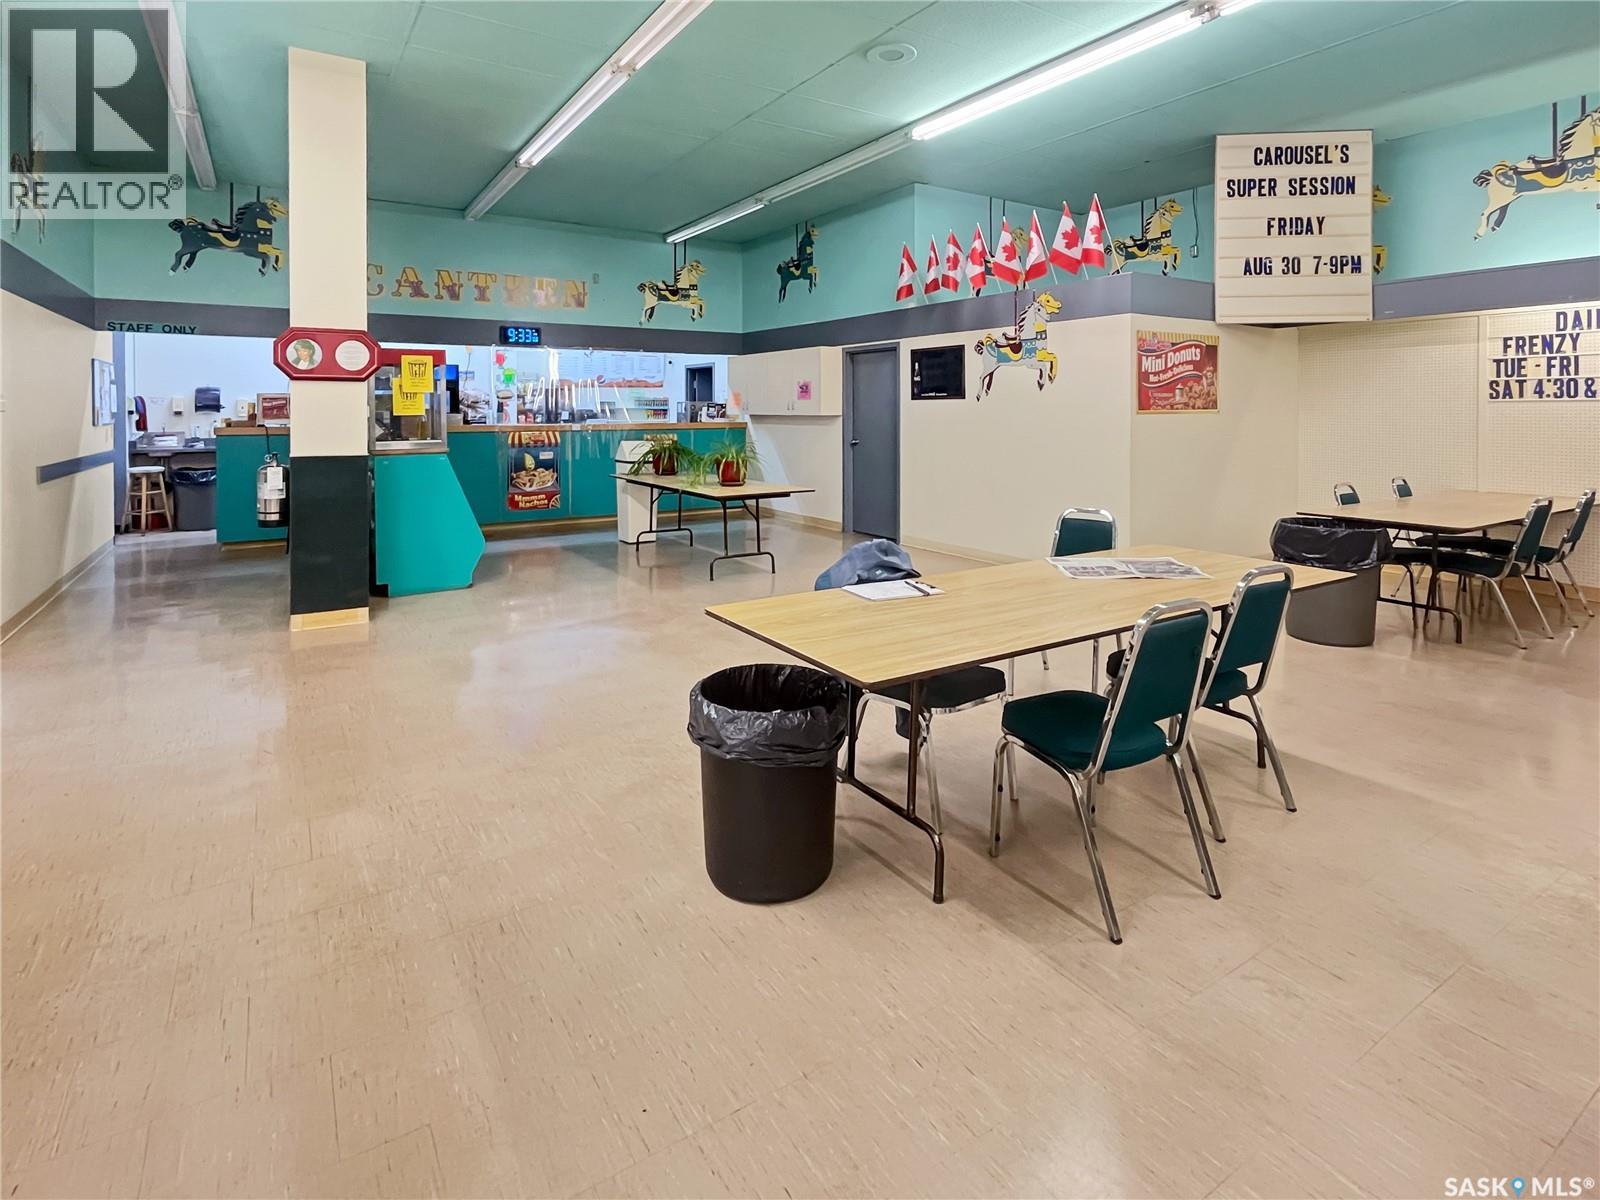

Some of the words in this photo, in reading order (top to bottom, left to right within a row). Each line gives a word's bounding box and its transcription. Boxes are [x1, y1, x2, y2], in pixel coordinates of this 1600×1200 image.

[1254, 144, 1349, 166] CAROUSEL'S
[1226, 178, 1277, 197] SUPER
[1288, 176, 1356, 196] SESSION
[1267, 216, 1325, 236] FRIDAY
[1243, 257, 1273, 276] AUG
[1281, 256, 1301, 275] 30
[1313, 255, 1362, 275] 7-9PM
[107, 321, 153, 332] STAFF
[162, 324, 197, 334] ONLY
[507, 328, 532, 343] 9:33
[1503, 333, 1581, 356] FRENZY
[1142, 354, 1166, 372] Mini
[1167, 345, 1201, 367] Donuts
[1492, 358, 1527, 378] TUE
[1546, 355, 1580, 377] FRI
[1489, 380, 1527, 400] SAT
[1533, 378, 1579, 399] 4:30
[1584, 377, 1598, 399] &
